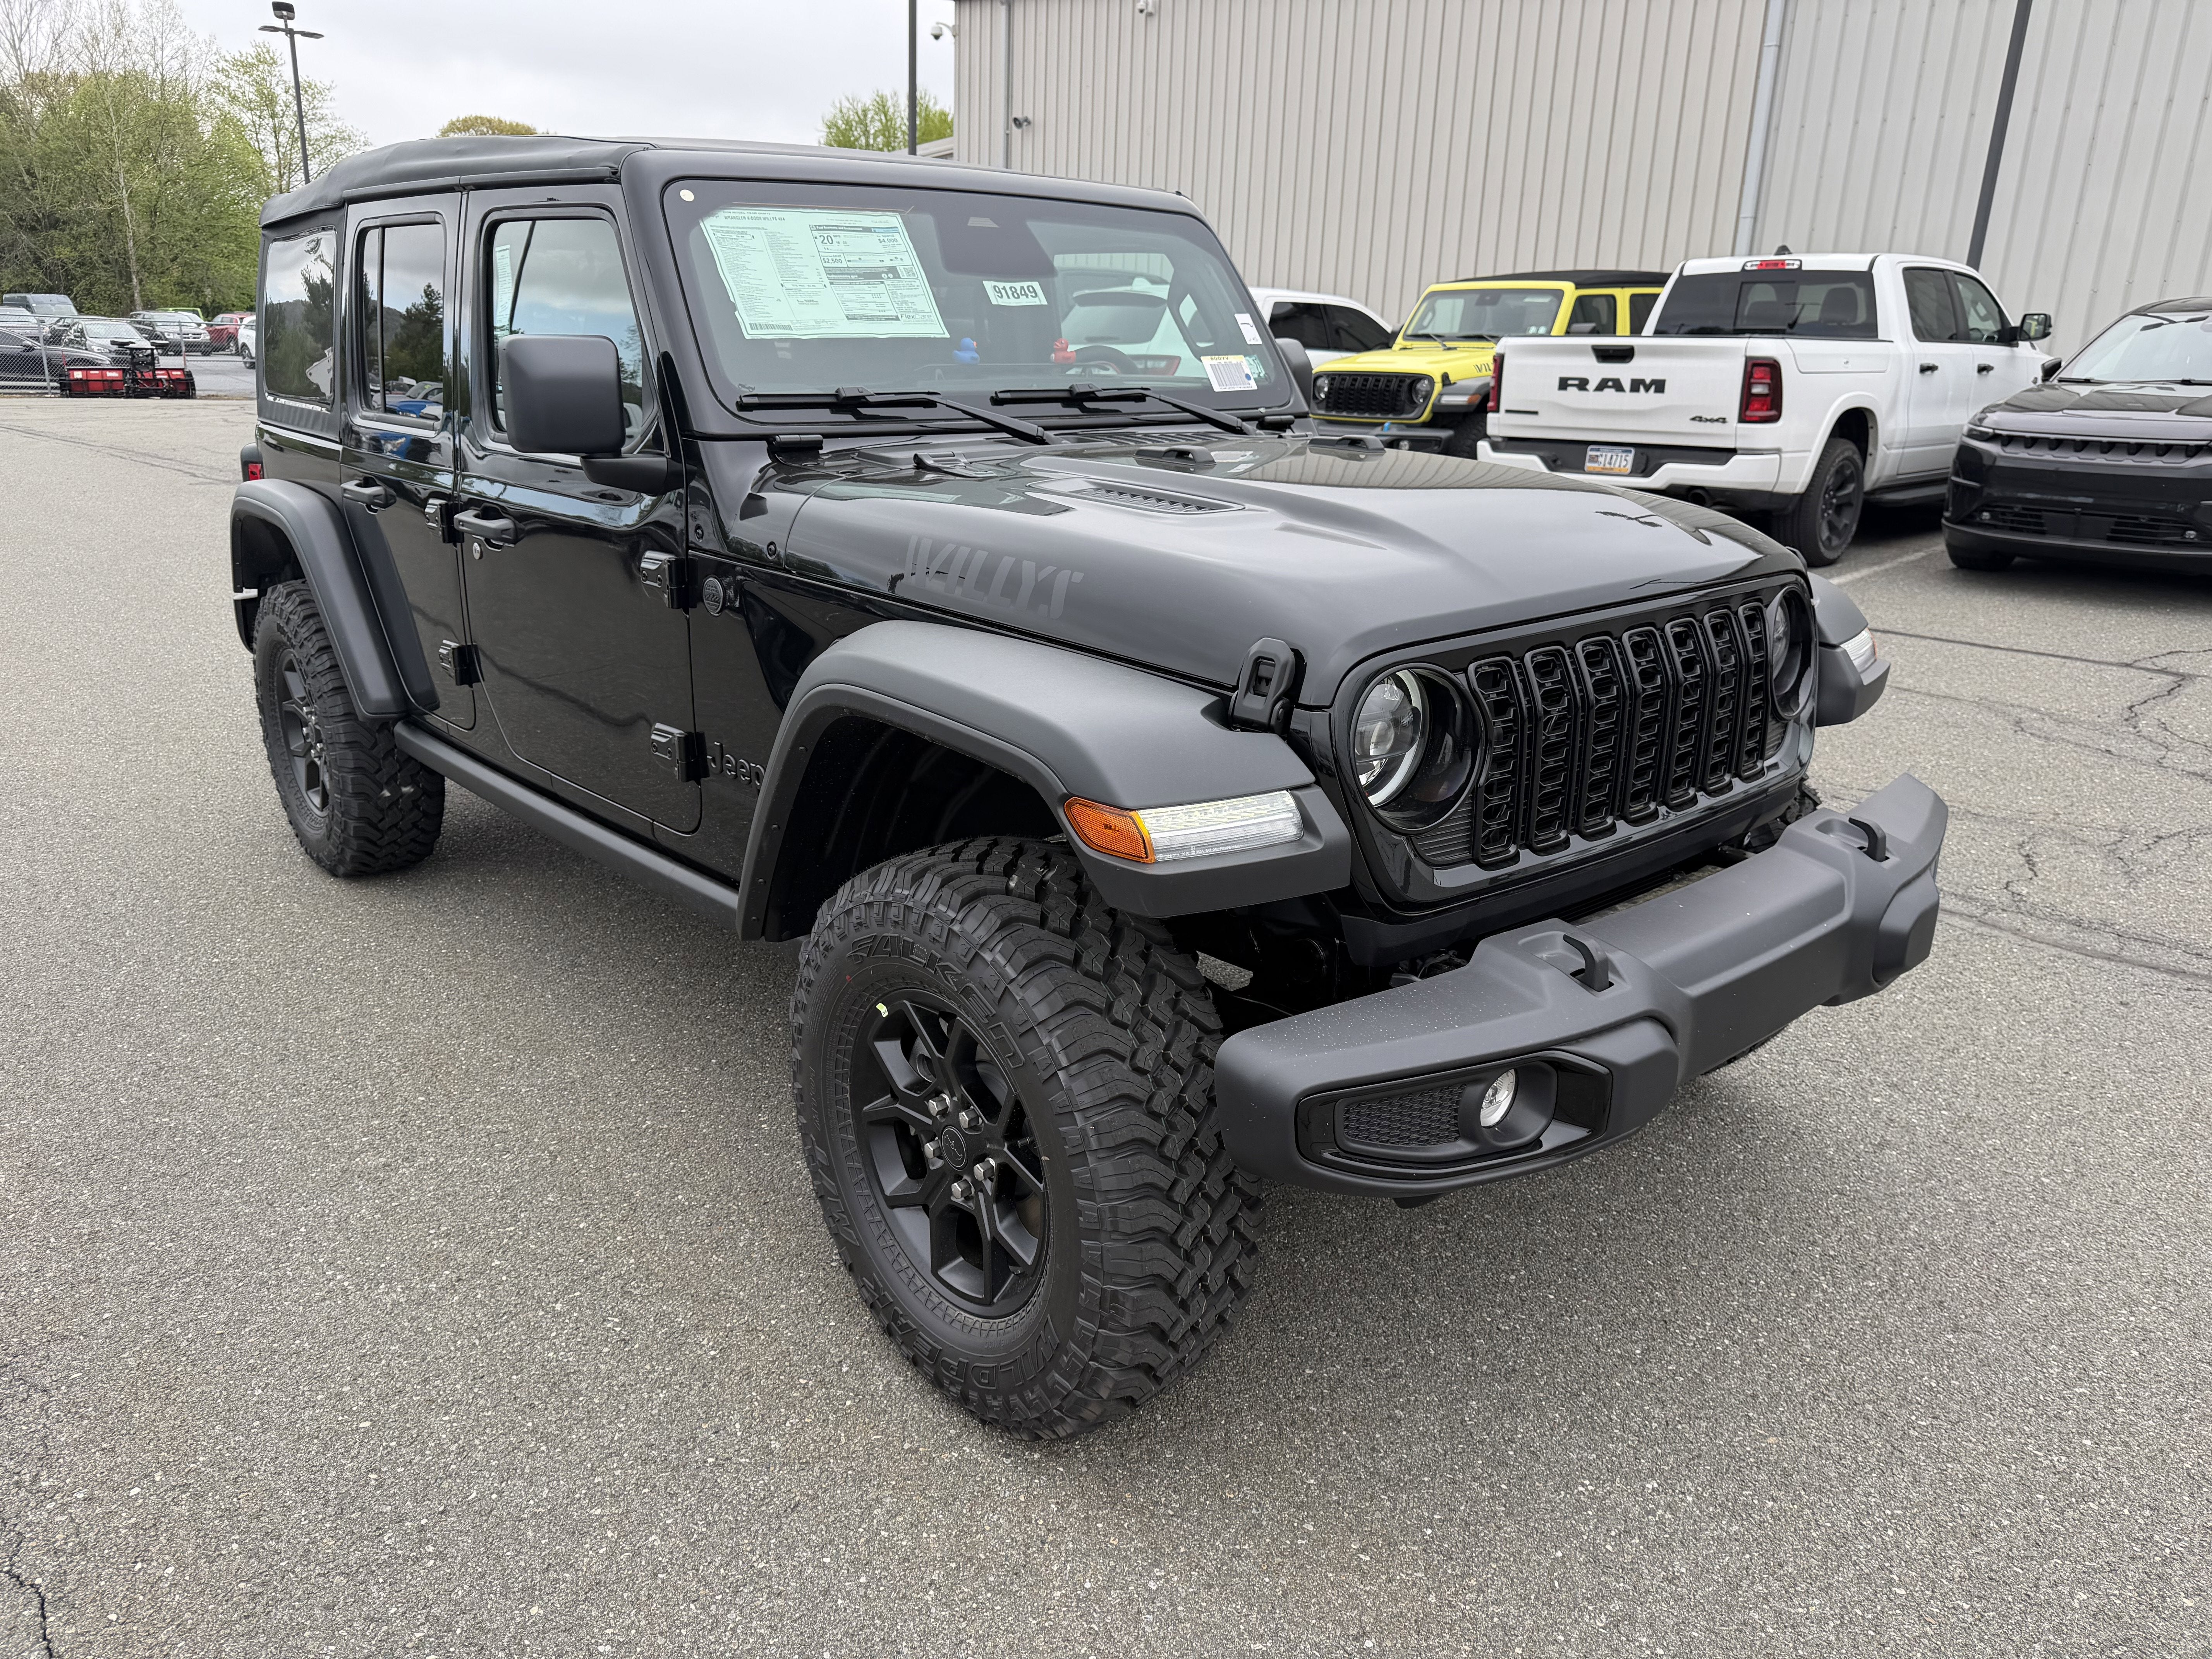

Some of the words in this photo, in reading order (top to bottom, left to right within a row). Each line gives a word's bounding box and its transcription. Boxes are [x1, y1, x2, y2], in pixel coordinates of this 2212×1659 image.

[819, 235, 833, 244] 20
[993, 285, 1038, 299] 91849
[1558, 376, 1666, 394] RAM
[905, 534, 1084, 620] WILLYS
[707, 742, 766, 794] Jeep
[846, 933, 1025, 1069] FALKEN
[861, 1273, 1060, 1389] WILDPEAK
